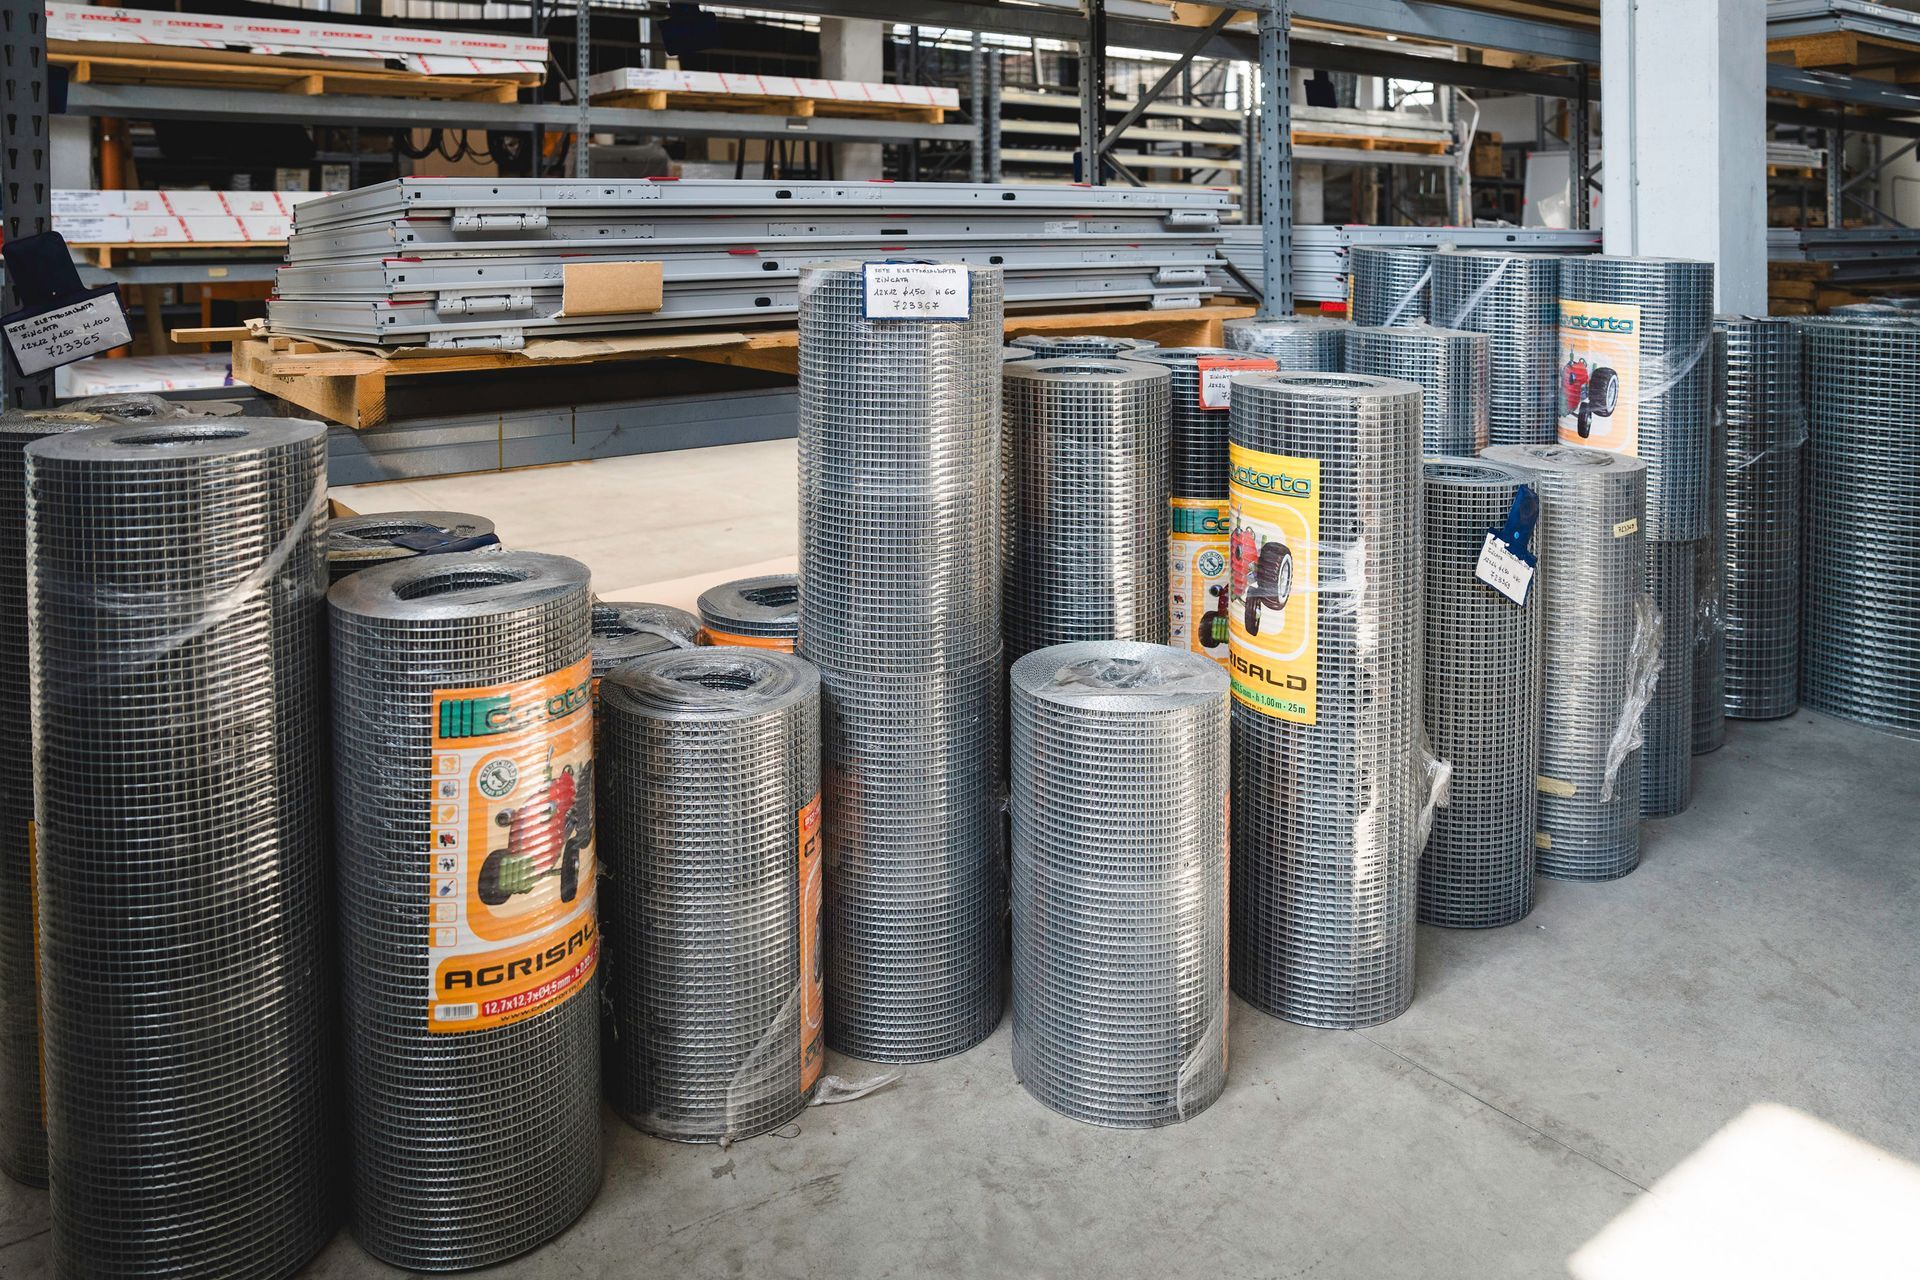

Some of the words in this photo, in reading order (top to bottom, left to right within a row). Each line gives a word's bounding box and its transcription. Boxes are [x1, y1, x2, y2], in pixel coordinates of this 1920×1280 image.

[935, 288, 941, 296] H
[944, 288, 956, 296] 60
[892, 300, 940, 311] 723367
[8, 323, 27, 334] RETE
[33, 302, 95, 326] ELETTROSALDATA
[93, 316, 111, 327] 100
[45, 332, 101, 357] 723365
[1288, 702, 1298, 713] 25
[1298, 706, 1306, 714] m
